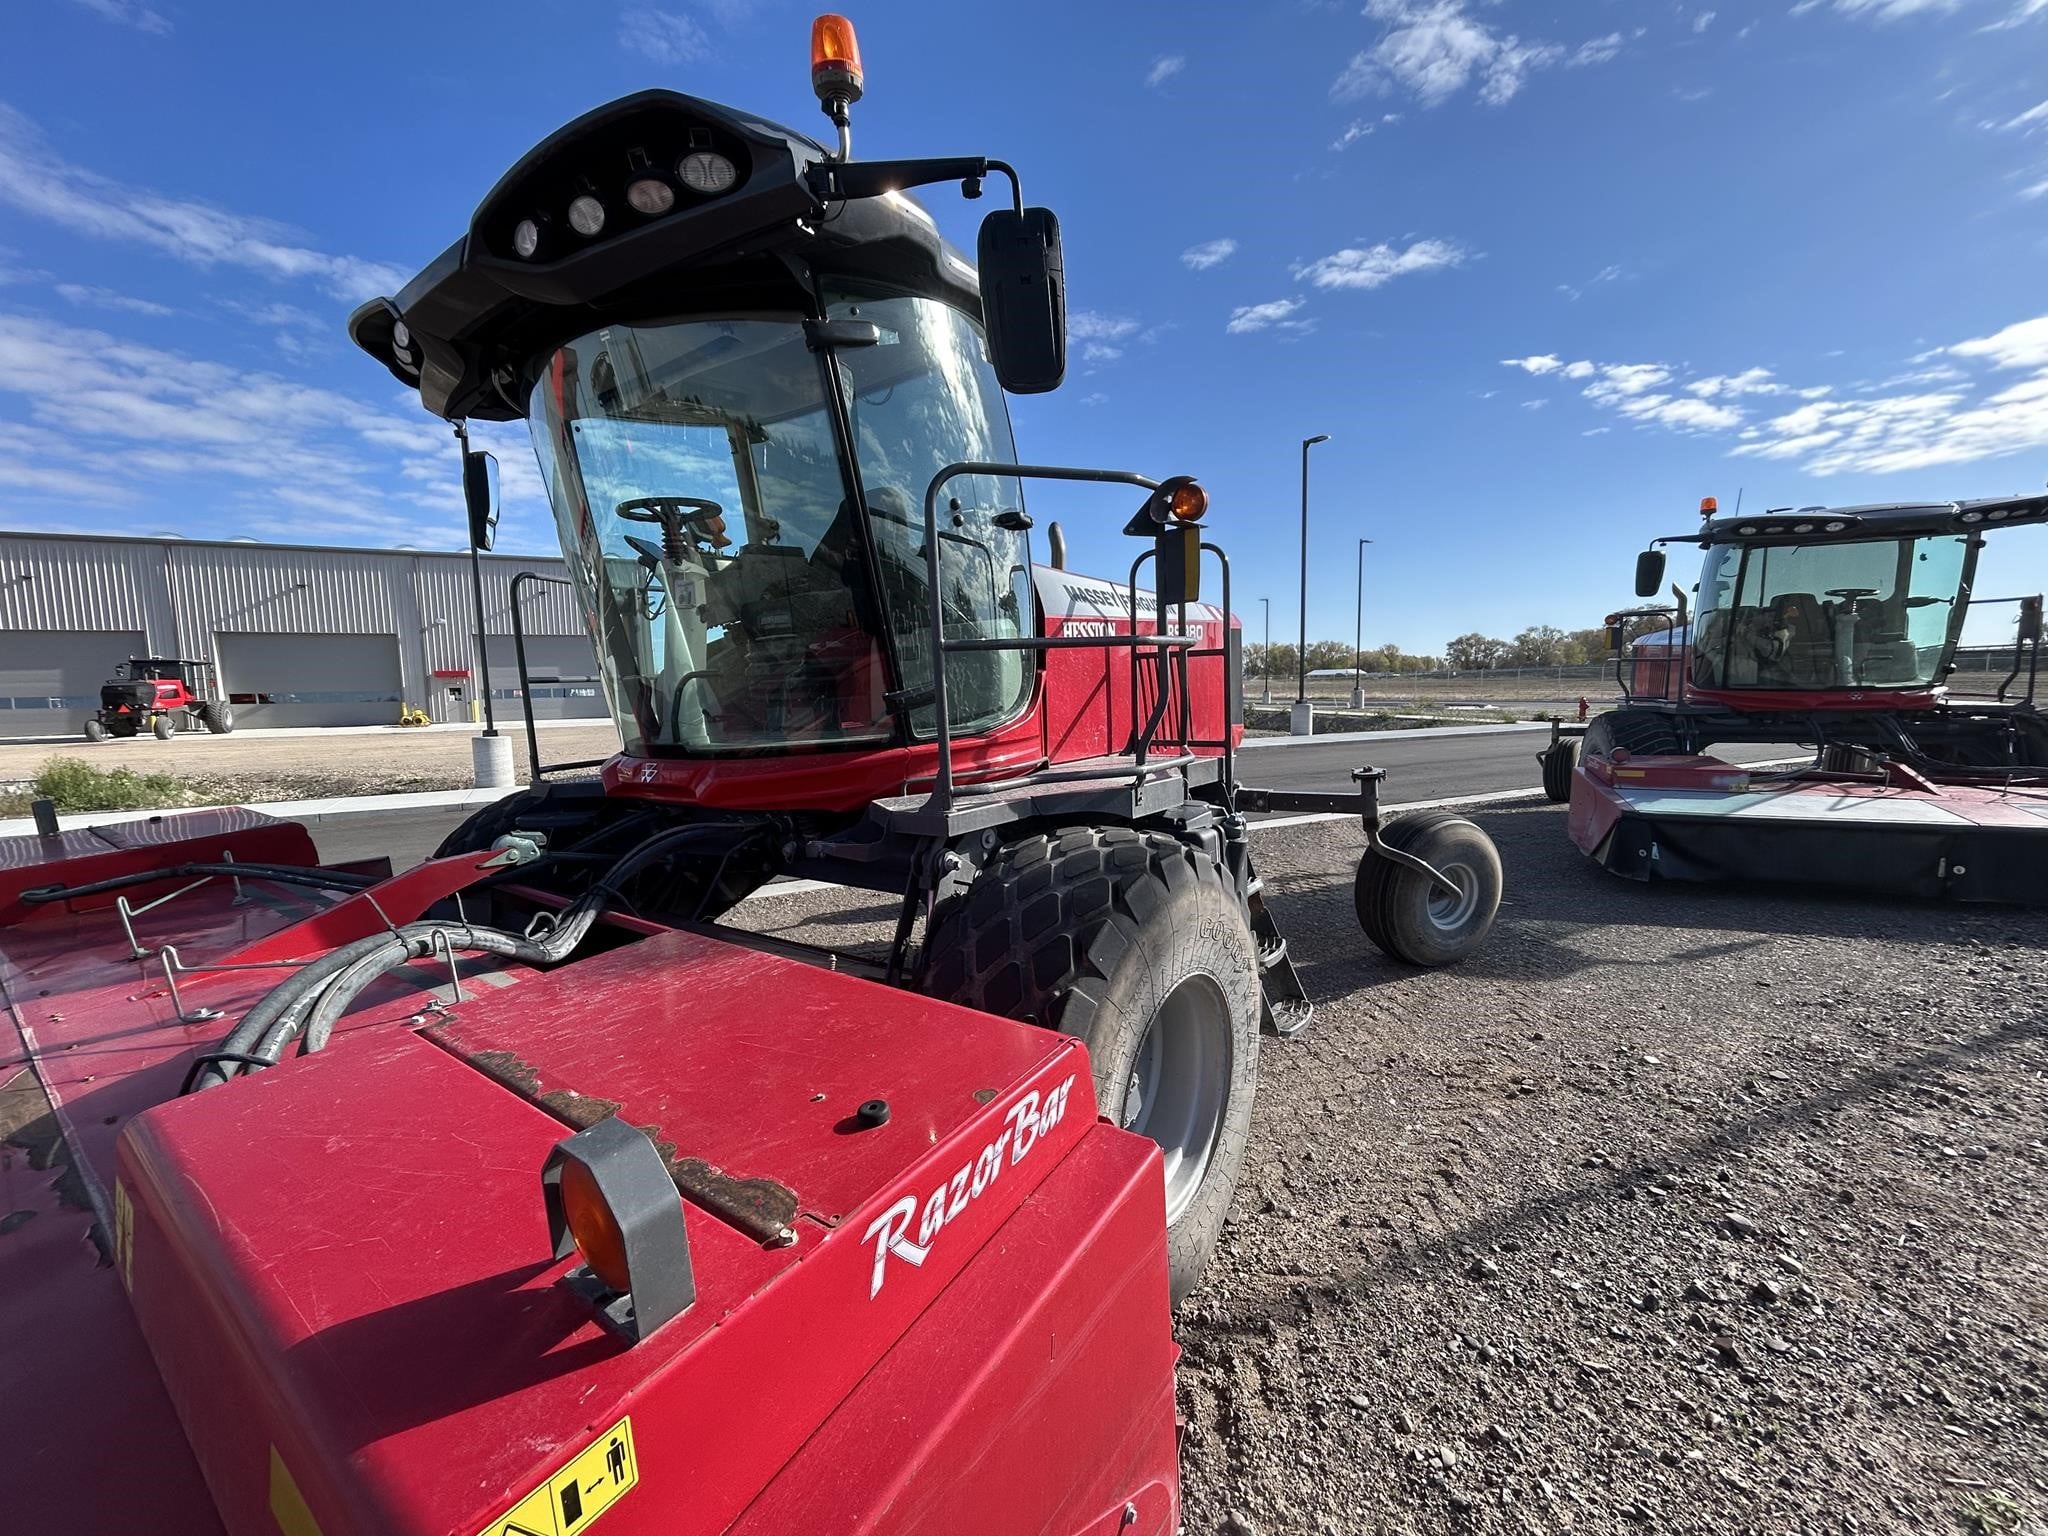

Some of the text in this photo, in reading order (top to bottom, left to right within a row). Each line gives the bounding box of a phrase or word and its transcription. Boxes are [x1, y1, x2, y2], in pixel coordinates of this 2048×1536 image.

[1063, 584, 1120, 608] MASSEY
[1063, 621, 1116, 638] HESSTON
[860, 1073, 1077, 1302] RazorBar
